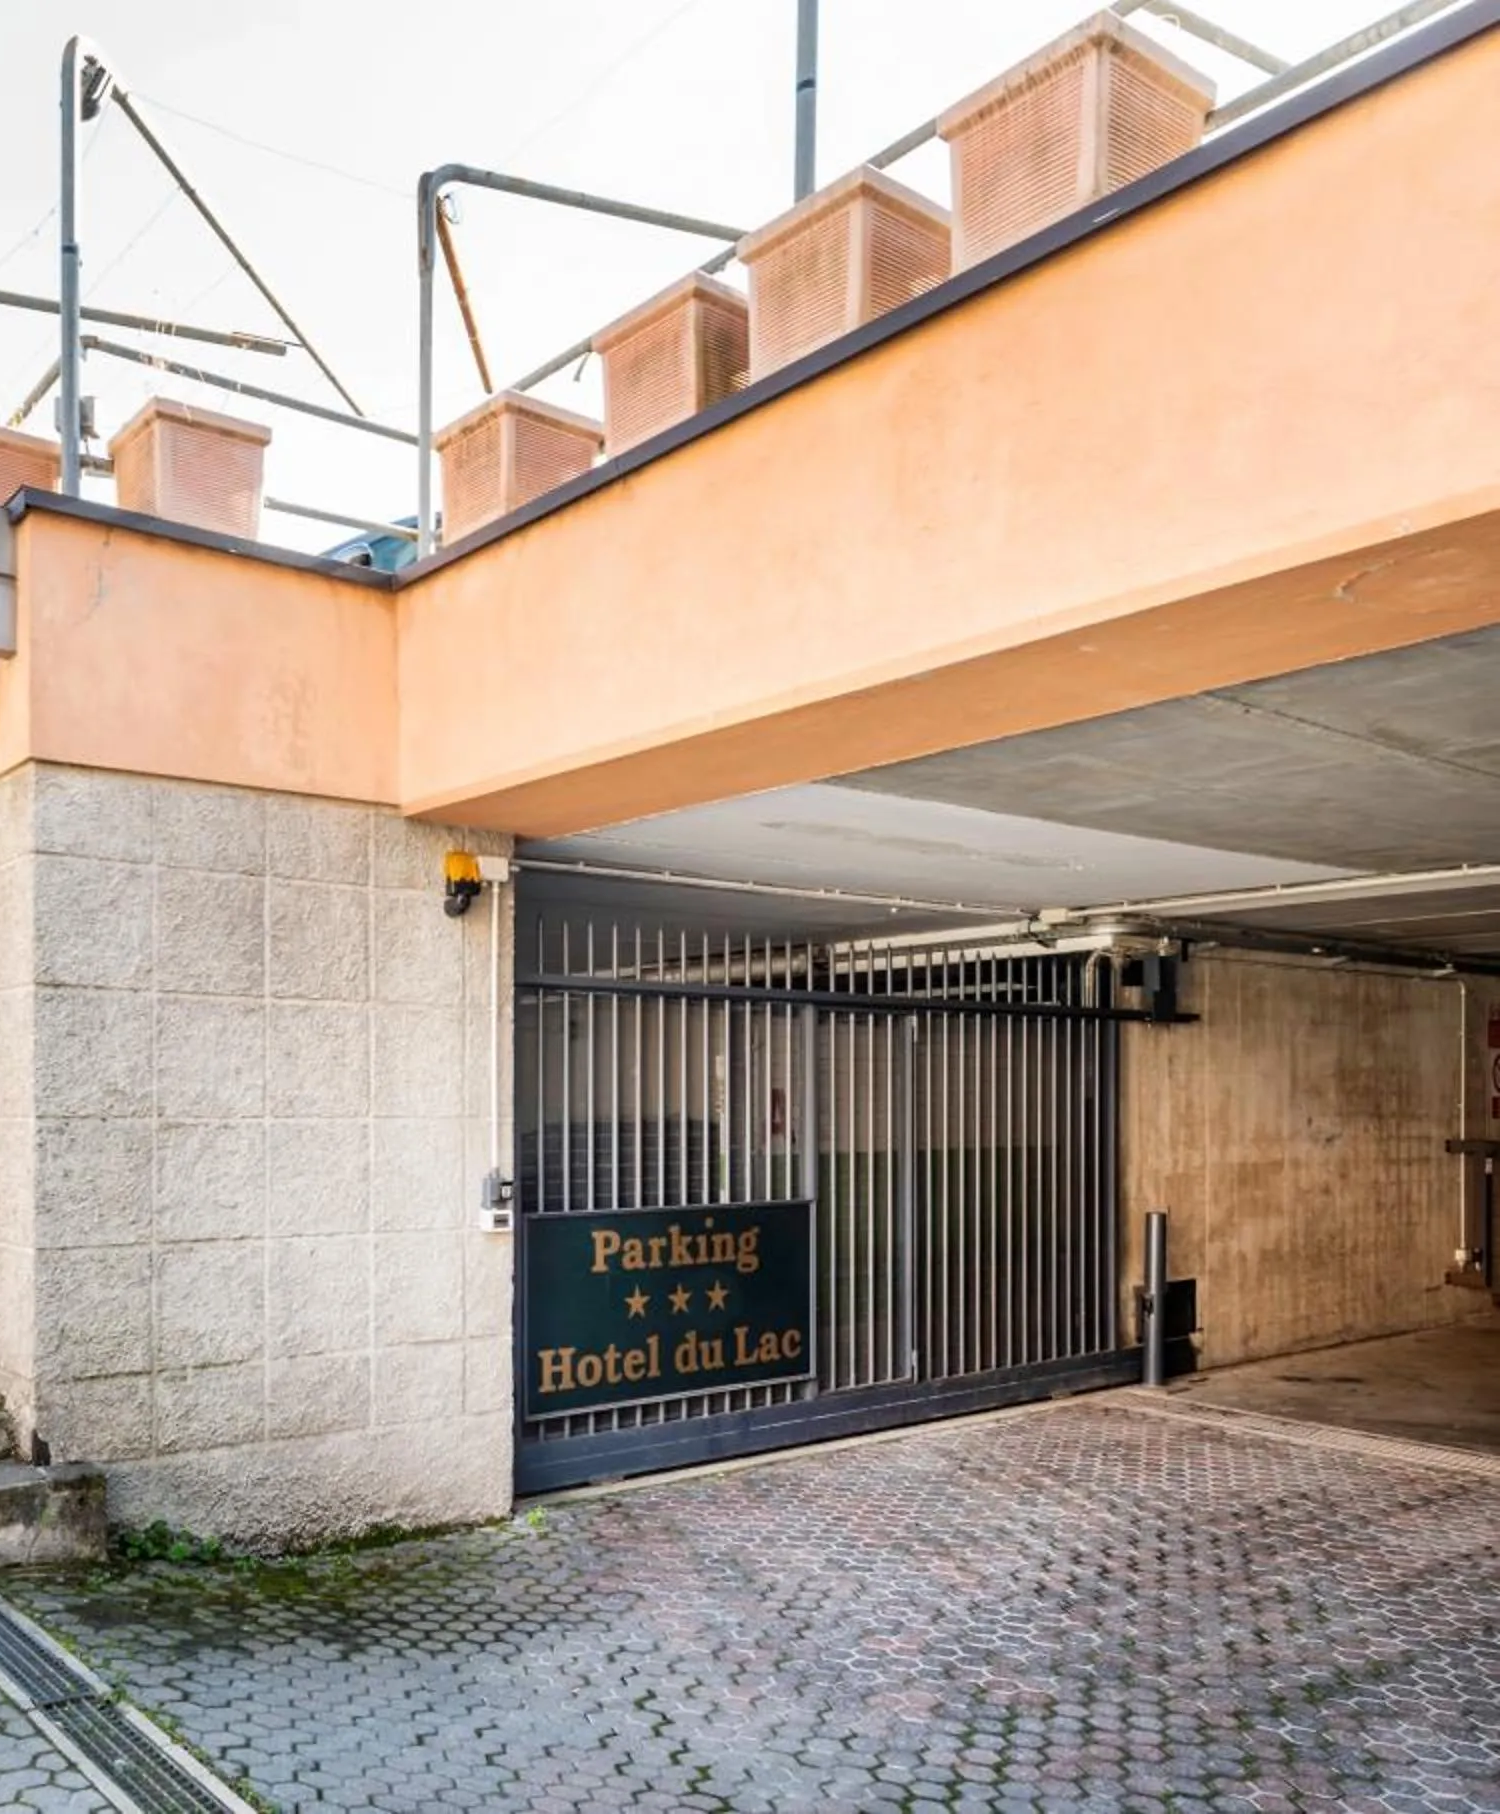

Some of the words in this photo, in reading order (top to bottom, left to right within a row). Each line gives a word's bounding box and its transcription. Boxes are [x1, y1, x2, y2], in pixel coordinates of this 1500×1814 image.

[590, 1217, 761, 1273] Parking
[537, 1334, 661, 1394] Hotel
[674, 1330, 725, 1375] du
[734, 1326, 803, 1366] Lac
